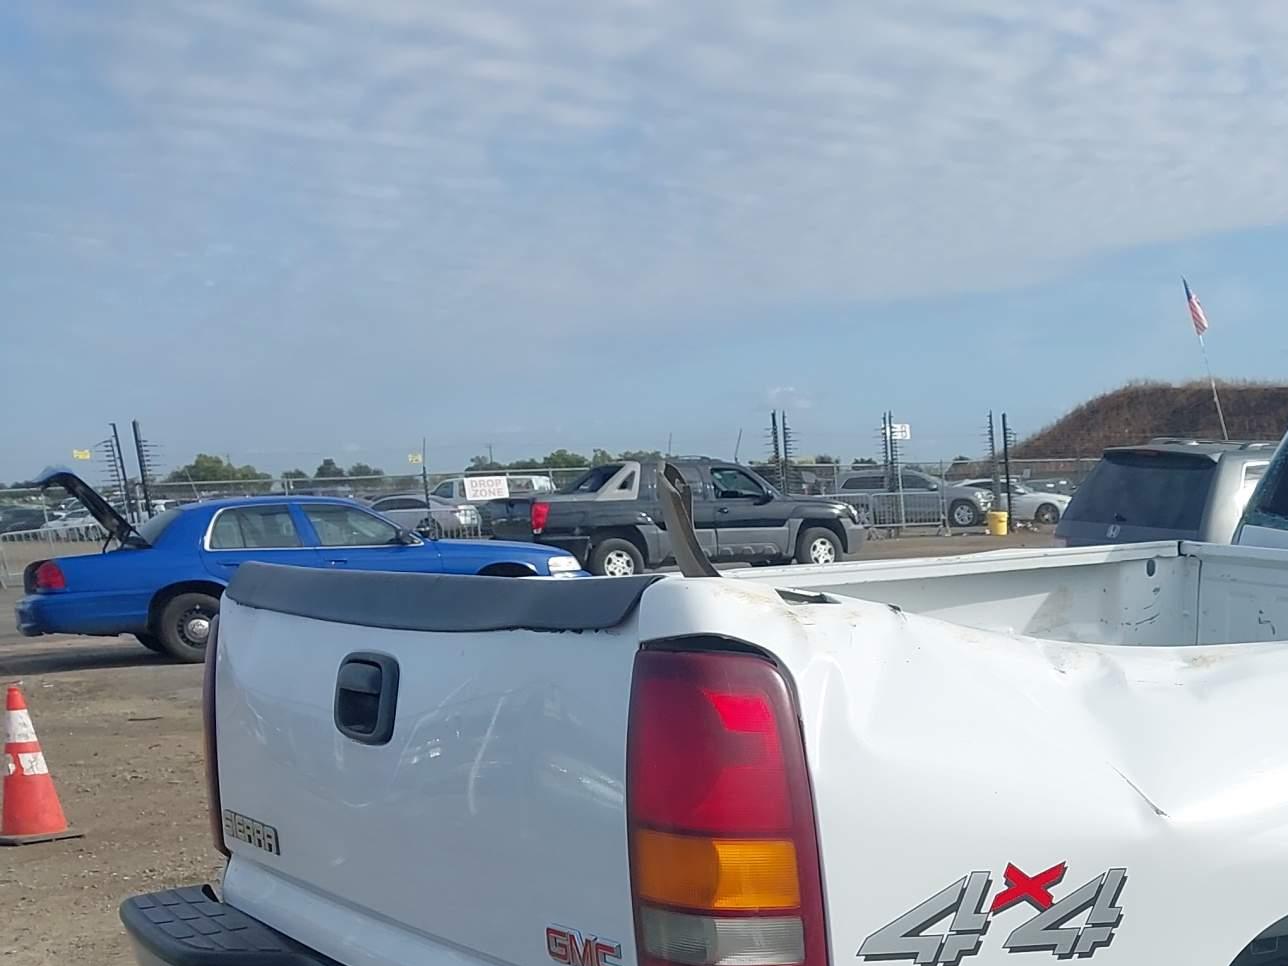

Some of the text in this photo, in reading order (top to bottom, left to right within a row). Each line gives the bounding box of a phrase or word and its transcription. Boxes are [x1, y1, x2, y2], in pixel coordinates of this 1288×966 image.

[471, 479, 503, 488] DROP
[472, 488, 505, 497] ZONE
[224, 810, 279, 855] SIERRA
